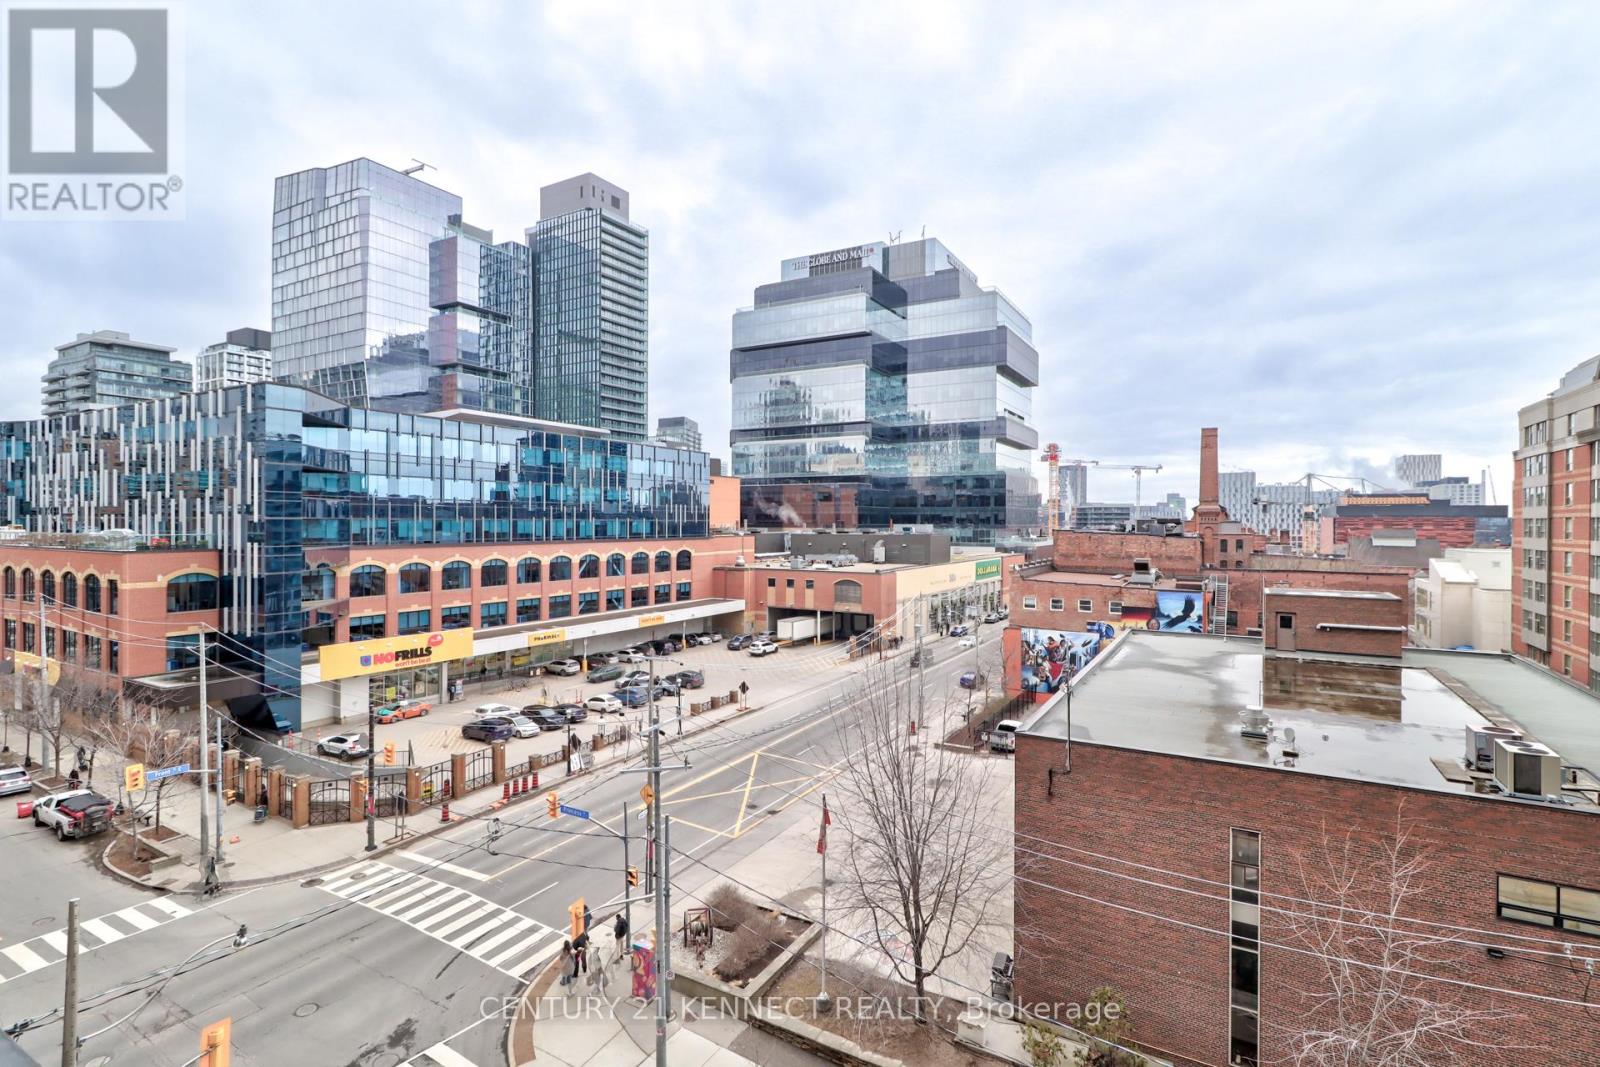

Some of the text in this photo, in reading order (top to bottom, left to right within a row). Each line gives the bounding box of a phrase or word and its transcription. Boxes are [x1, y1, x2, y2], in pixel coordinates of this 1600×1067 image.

[808, 254, 831, 267] GLOBE
[832, 251, 848, 263] AND
[849, 247, 870, 260] MAIL
[154, 768, 171, 778] Front
